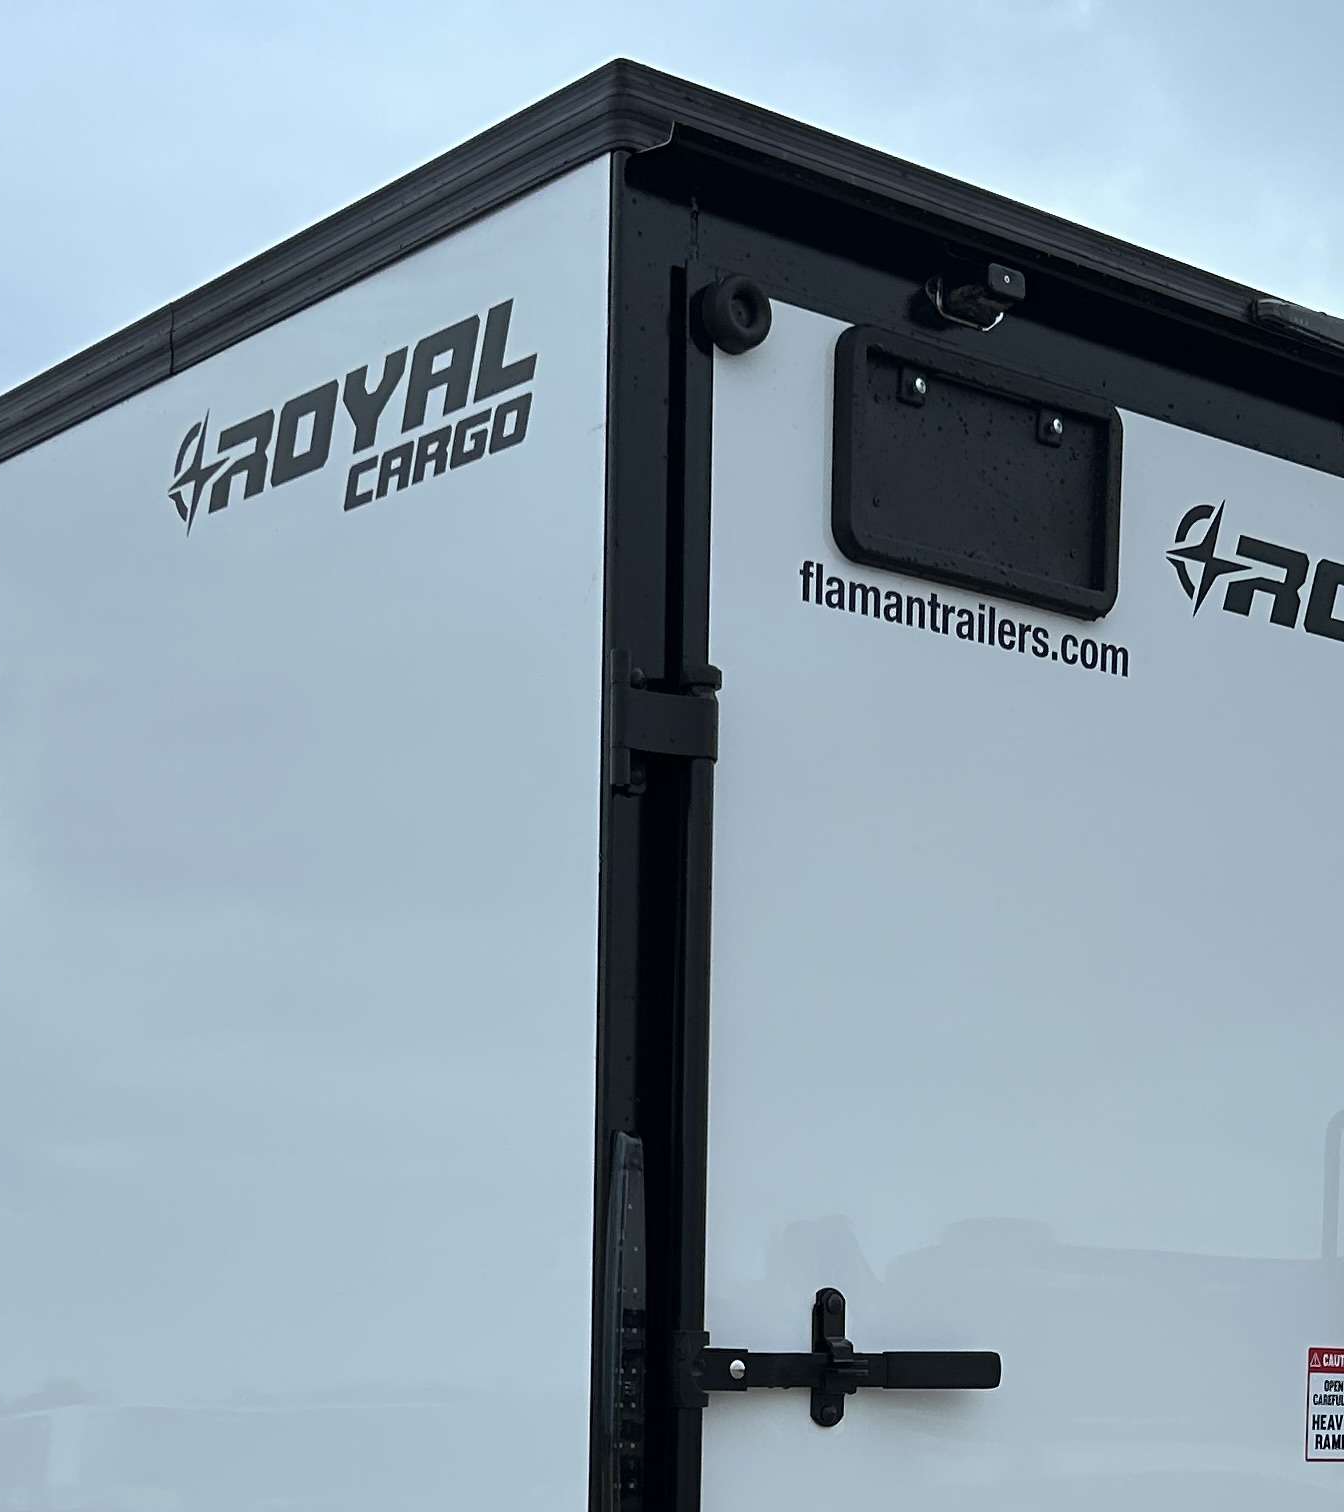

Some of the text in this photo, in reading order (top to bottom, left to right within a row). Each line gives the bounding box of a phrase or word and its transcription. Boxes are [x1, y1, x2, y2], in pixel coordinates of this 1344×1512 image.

[207, 298, 538, 515] ROYAL
[343, 392, 533, 512] CARGO
[799, 560, 1129, 677] flamantrailers.com
[1324, 1380, 1344, 1392] OPEN
